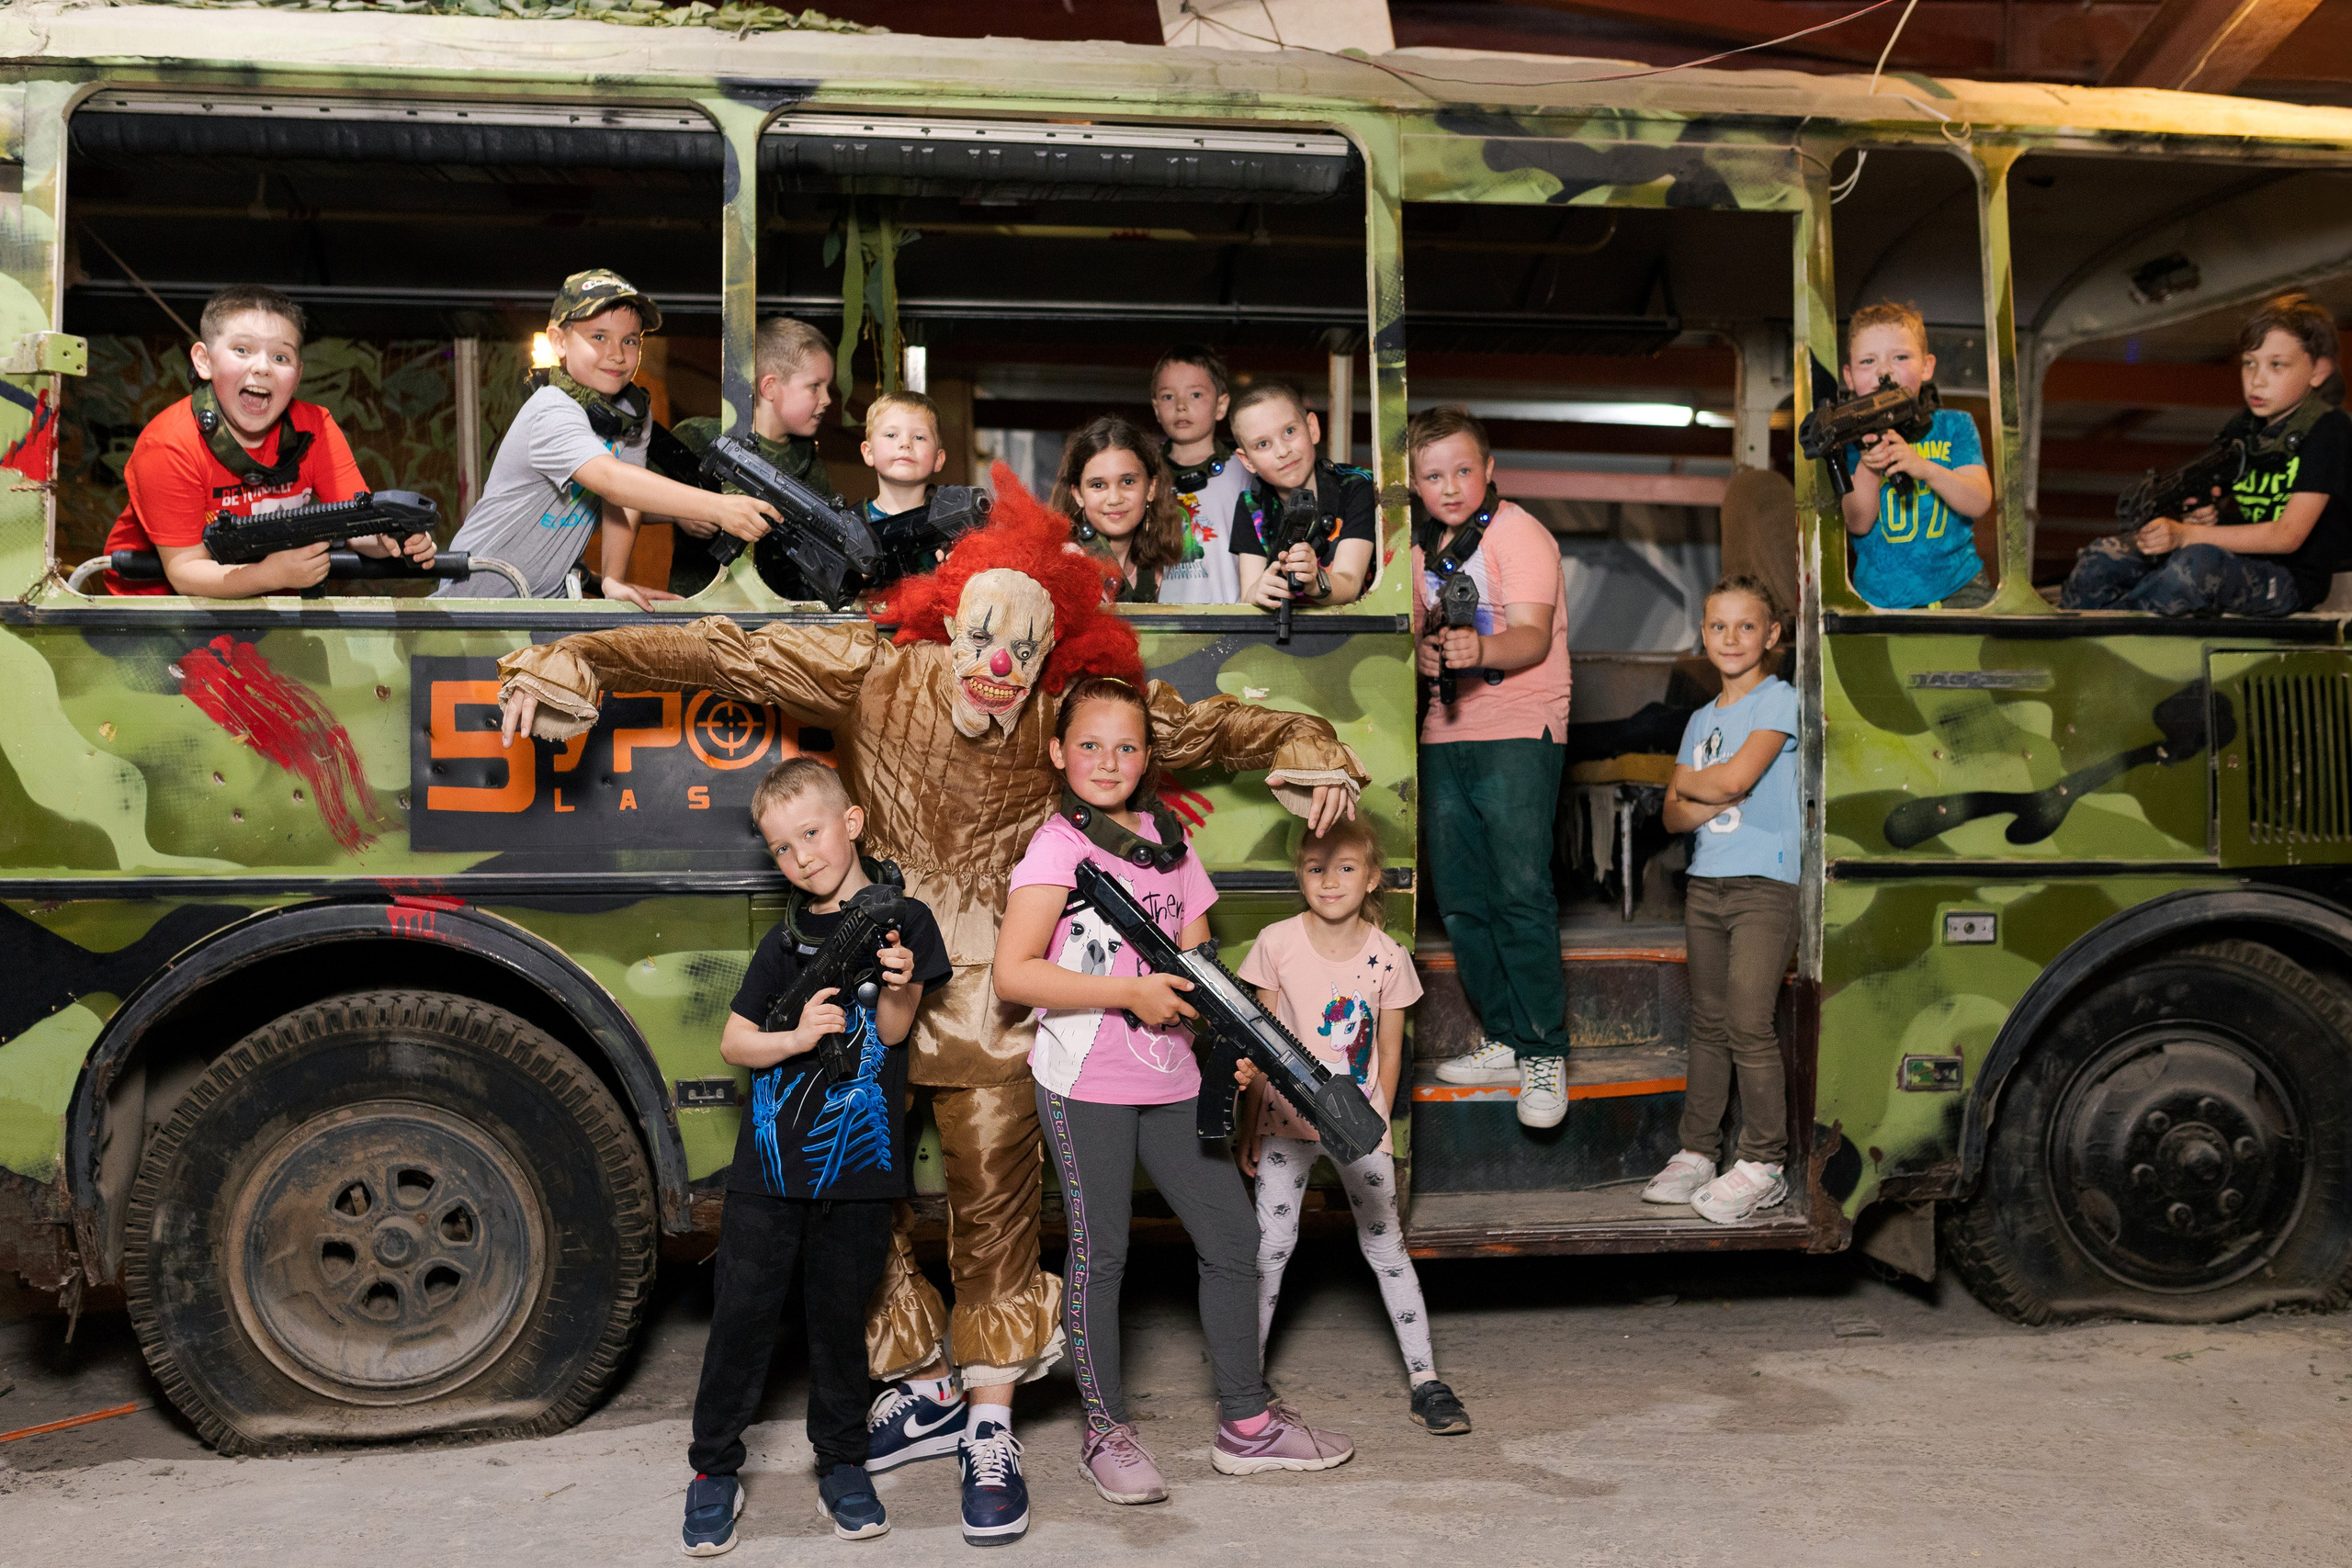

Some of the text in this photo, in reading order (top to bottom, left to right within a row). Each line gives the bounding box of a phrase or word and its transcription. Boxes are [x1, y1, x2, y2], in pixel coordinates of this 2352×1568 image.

[1049, 1092, 1061, 1107] of
[1053, 1111, 1067, 1140] Star
[1061, 1142, 1073, 1168] City
[1069, 1172, 1079, 1187] of
[1070, 1189, 1081, 1218] Star
[1072, 1220, 1084, 1244] City
[1076, 1247, 1086, 1262] of
[1074, 1263, 1086, 1291] Star
[1070, 1292, 1082, 1318] City
[1072, 1321, 1084, 1336] of
[1074, 1337, 1086, 1364] Star
[1080, 1366, 1092, 1389] City
[1087, 1392, 1100, 1404] of
